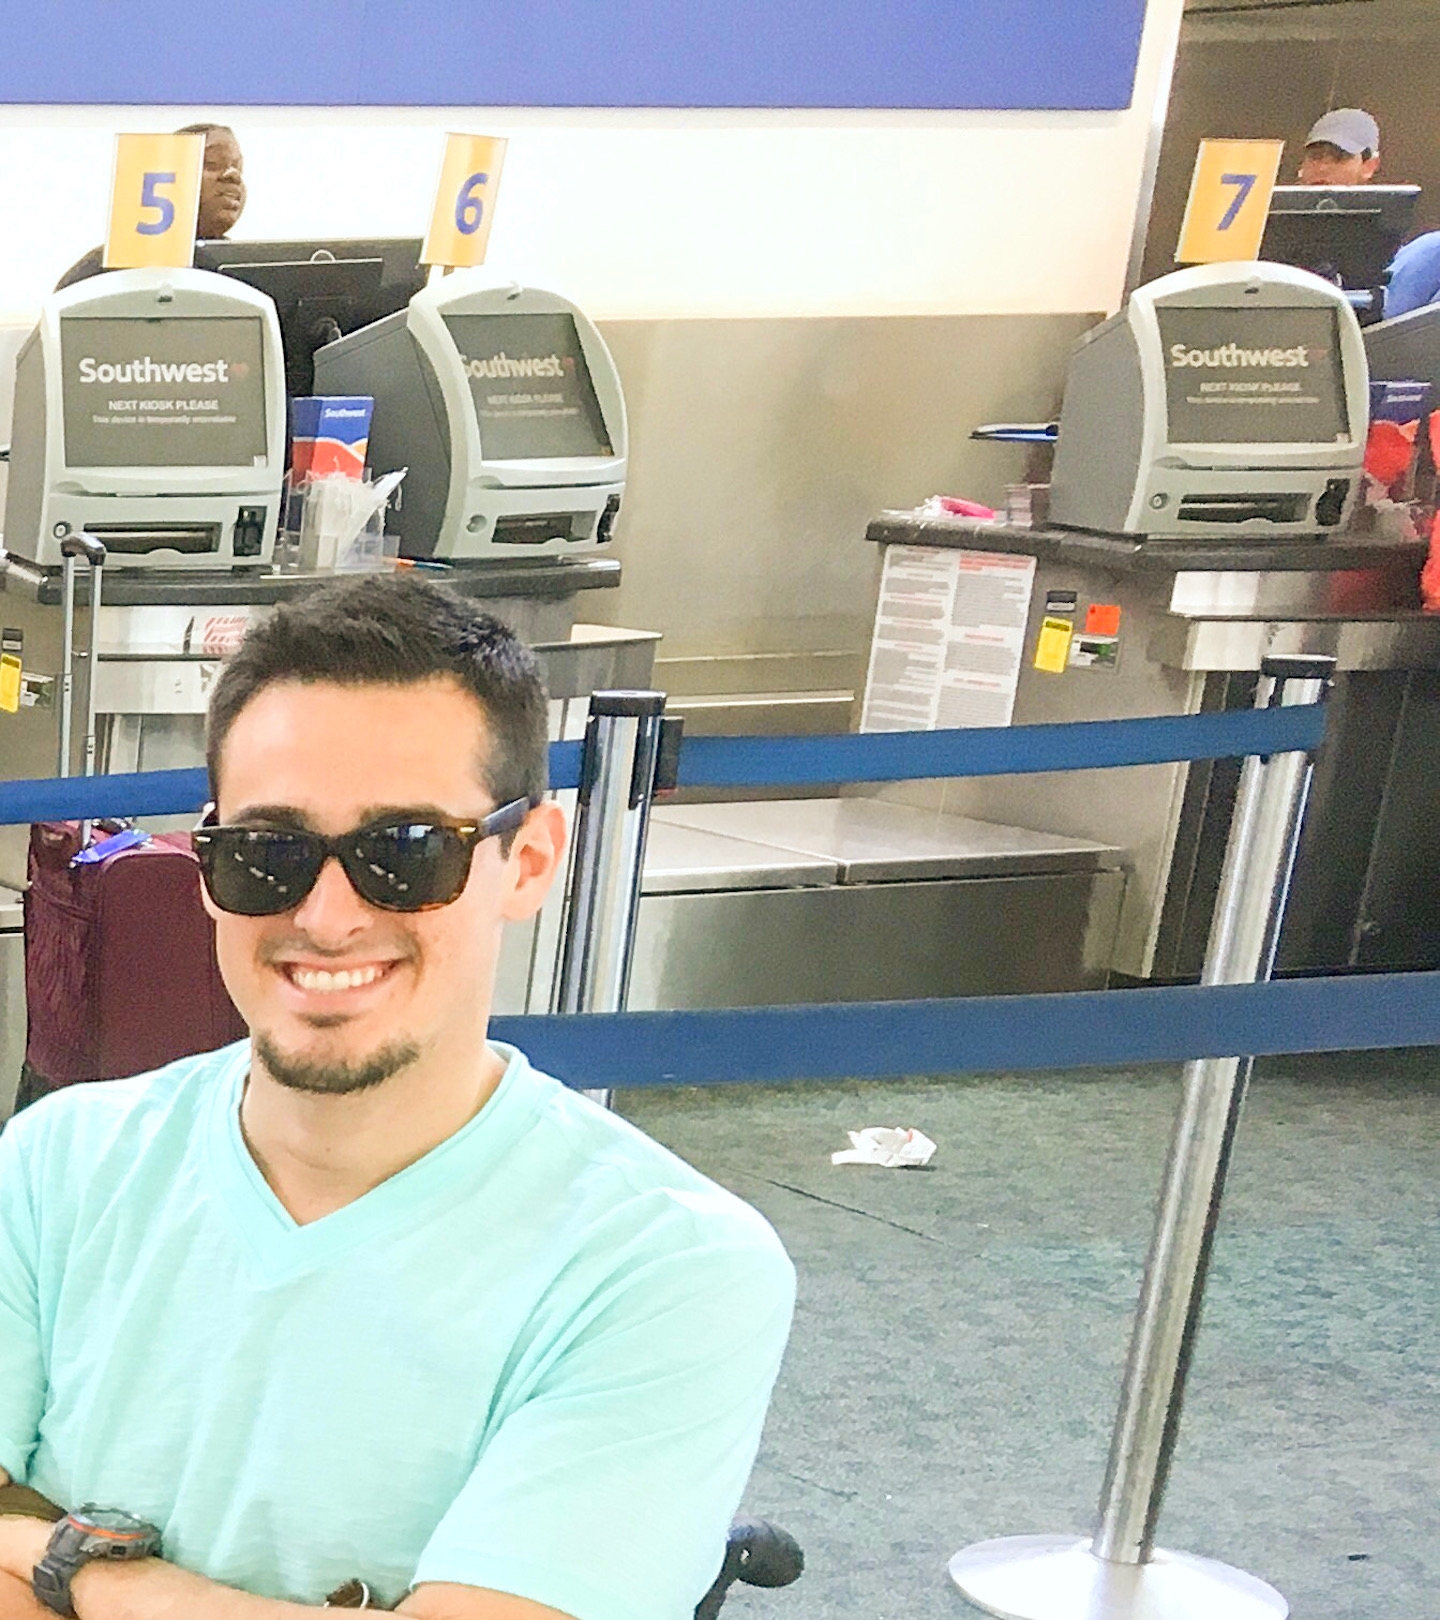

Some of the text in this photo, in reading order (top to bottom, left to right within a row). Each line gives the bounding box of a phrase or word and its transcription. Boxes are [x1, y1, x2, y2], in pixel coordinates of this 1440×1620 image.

[136, 172, 176, 235] 5
[455, 172, 488, 235] 6
[1217, 173, 1258, 230] 7
[78, 356, 230, 383] Southwest
[1171, 342, 1309, 368] Southwest
[108, 400, 219, 410] NEXT KIOSK PLEASE
